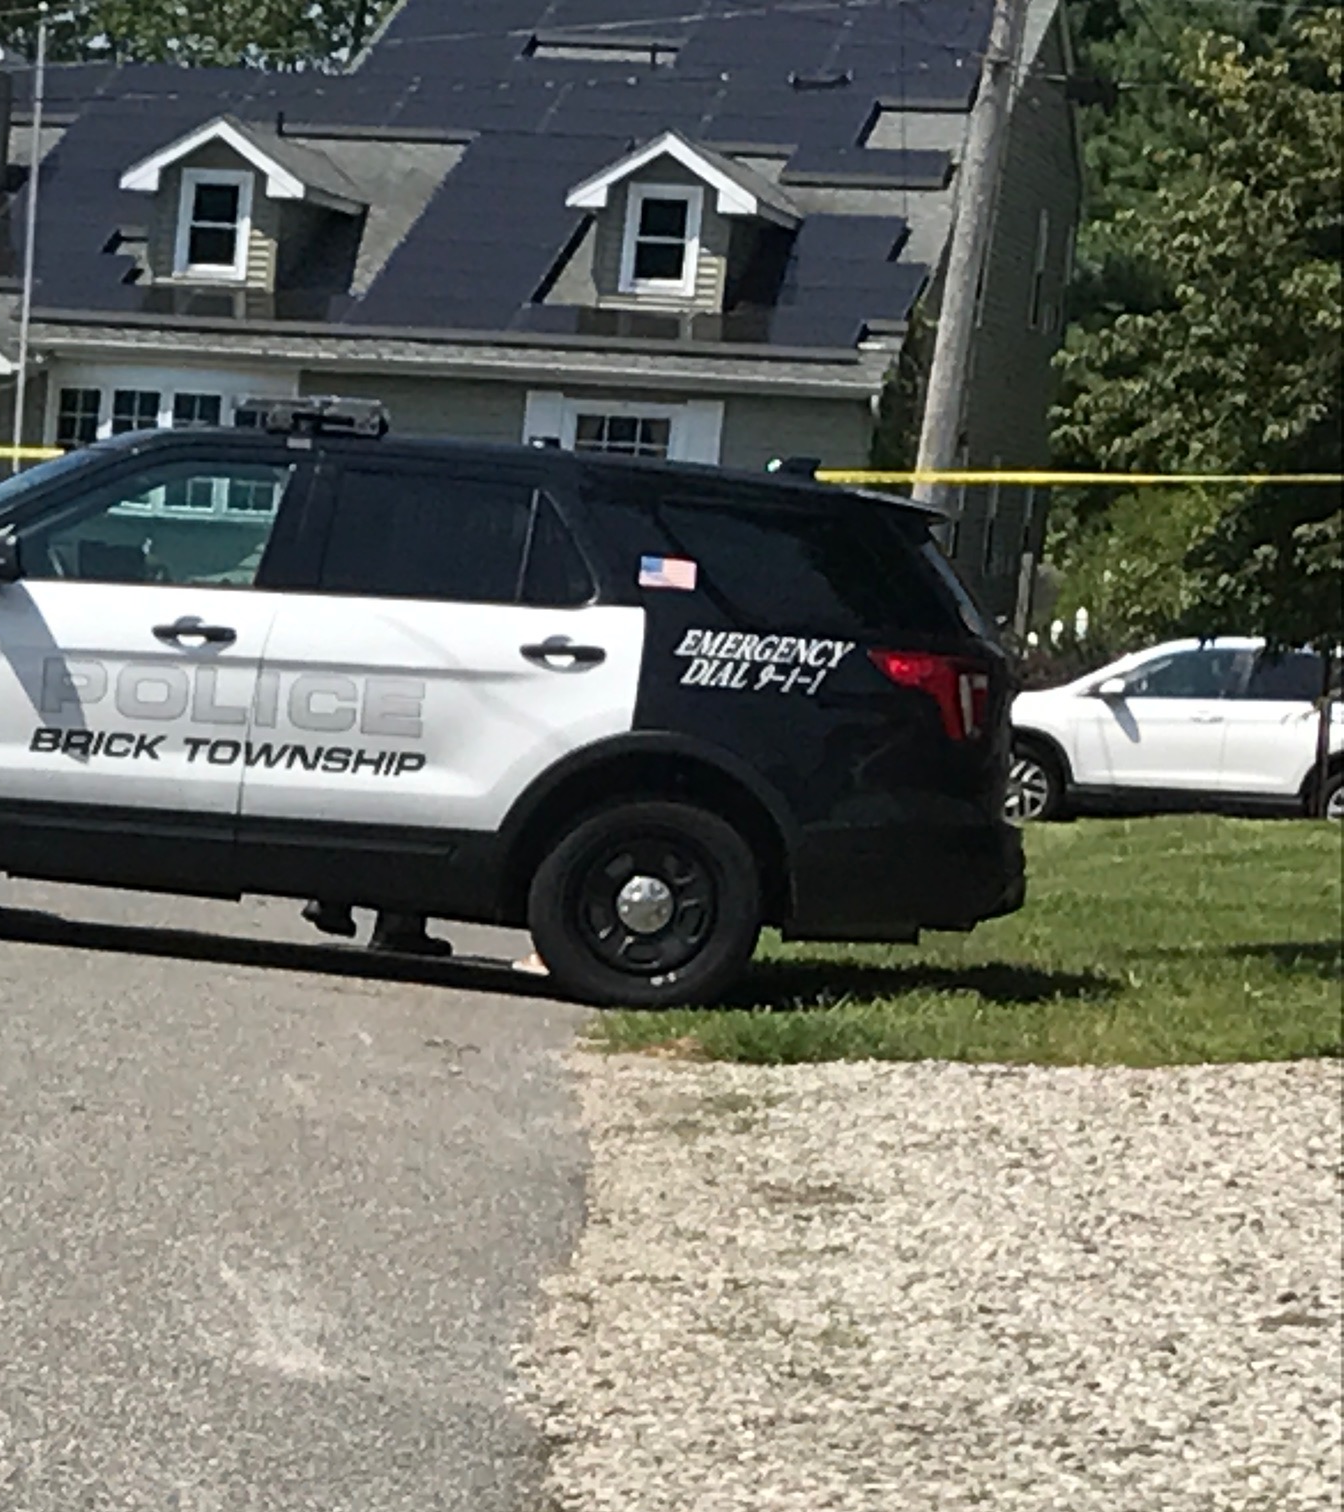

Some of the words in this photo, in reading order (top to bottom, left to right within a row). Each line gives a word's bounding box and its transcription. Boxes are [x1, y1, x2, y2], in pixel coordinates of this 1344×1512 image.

[673, 629, 856, 668] EMERGENCY
[40, 657, 425, 738] POLICE
[680, 658, 750, 689] DIAL
[753, 664, 827, 695] 9-1-1
[29, 728, 166, 760] BRICK
[183, 737, 425, 776] TOWNSHIP
